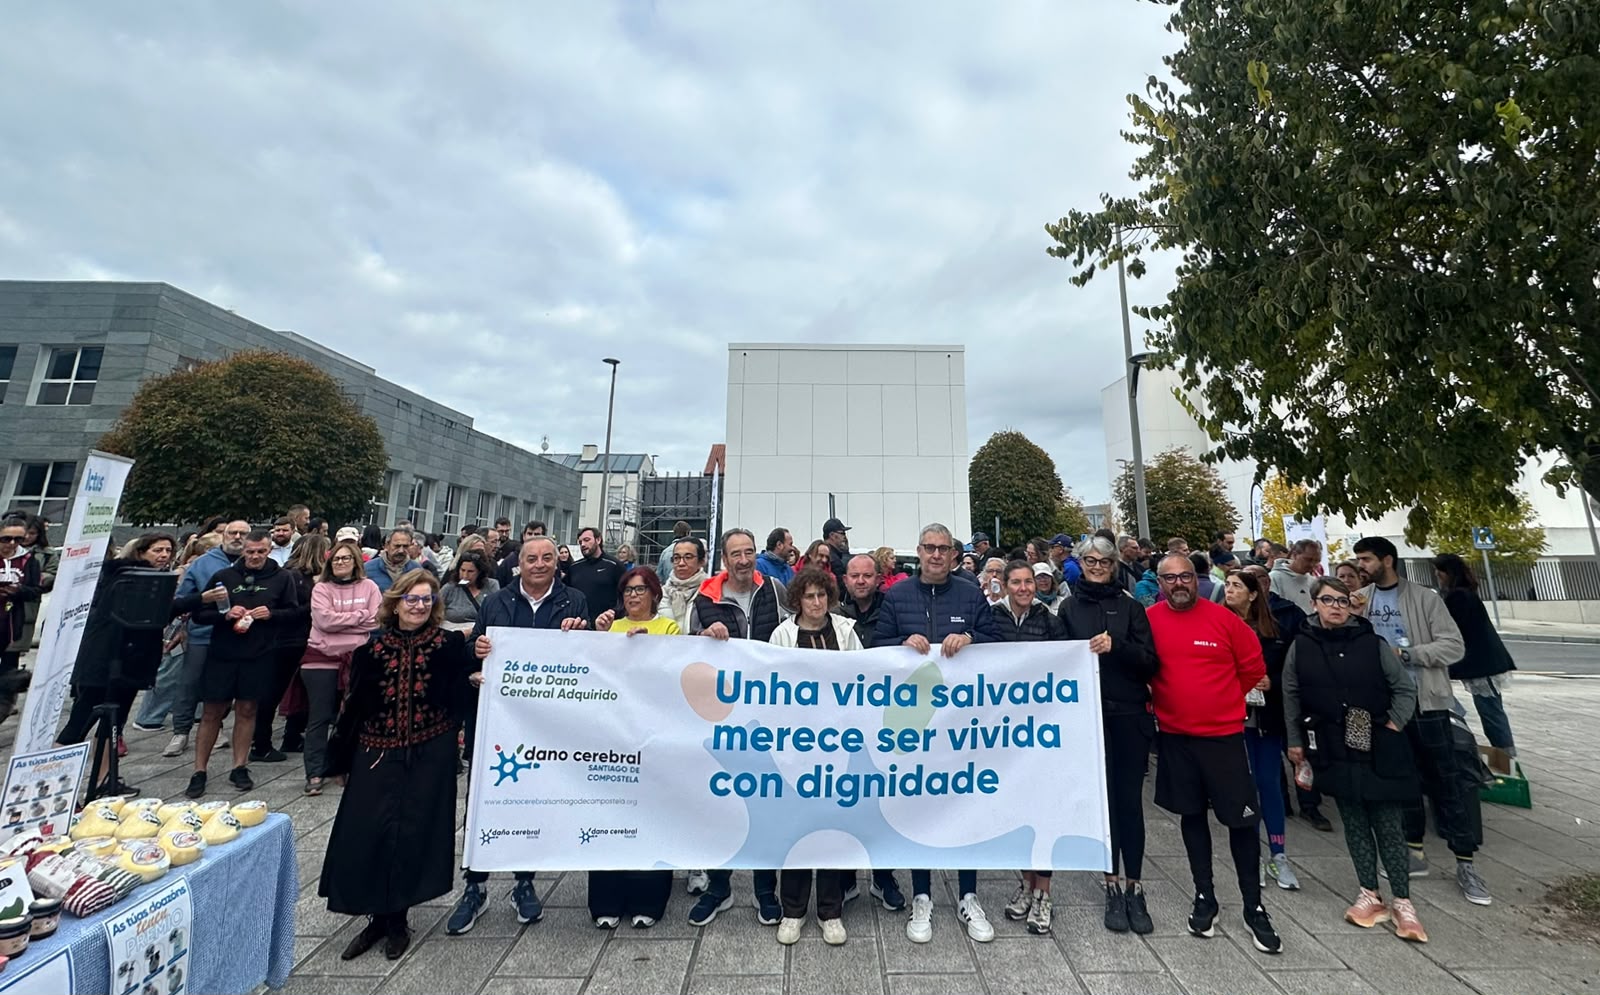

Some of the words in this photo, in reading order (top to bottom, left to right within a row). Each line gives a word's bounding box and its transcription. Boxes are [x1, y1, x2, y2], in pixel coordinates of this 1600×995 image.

[504, 660, 520, 672] 26
[522, 661, 538, 673] de
[541, 663, 590, 675] outubro
[502, 673, 523, 684] Dia
[526, 674, 542, 685] do
[545, 674, 578, 686] Dano
[500, 685, 555, 699] Cerebral
[556, 688, 618, 702] Adquirido
[716, 670, 819, 706] Unha
[832, 674, 918, 707] vida
[930, 672, 1079, 708] salvada
[712, 724, 864, 753] merece
[876, 727, 937, 753] ser
[947, 715, 1062, 751] vivida
[524, 746, 569, 762] dano
[573, 750, 642, 765] cerebral
[588, 764, 628, 773] SANTIAGO
[630, 765, 640, 774] DE
[587, 774, 639, 784] COMPOSTELA
[709, 771, 783, 798] con
[796, 762, 999, 807] dignidade
[511, 828, 541, 836] cerebral
[113, 923, 126, 937] As
[126, 908, 149, 927] túas
[149, 886, 187, 912] doazóns
